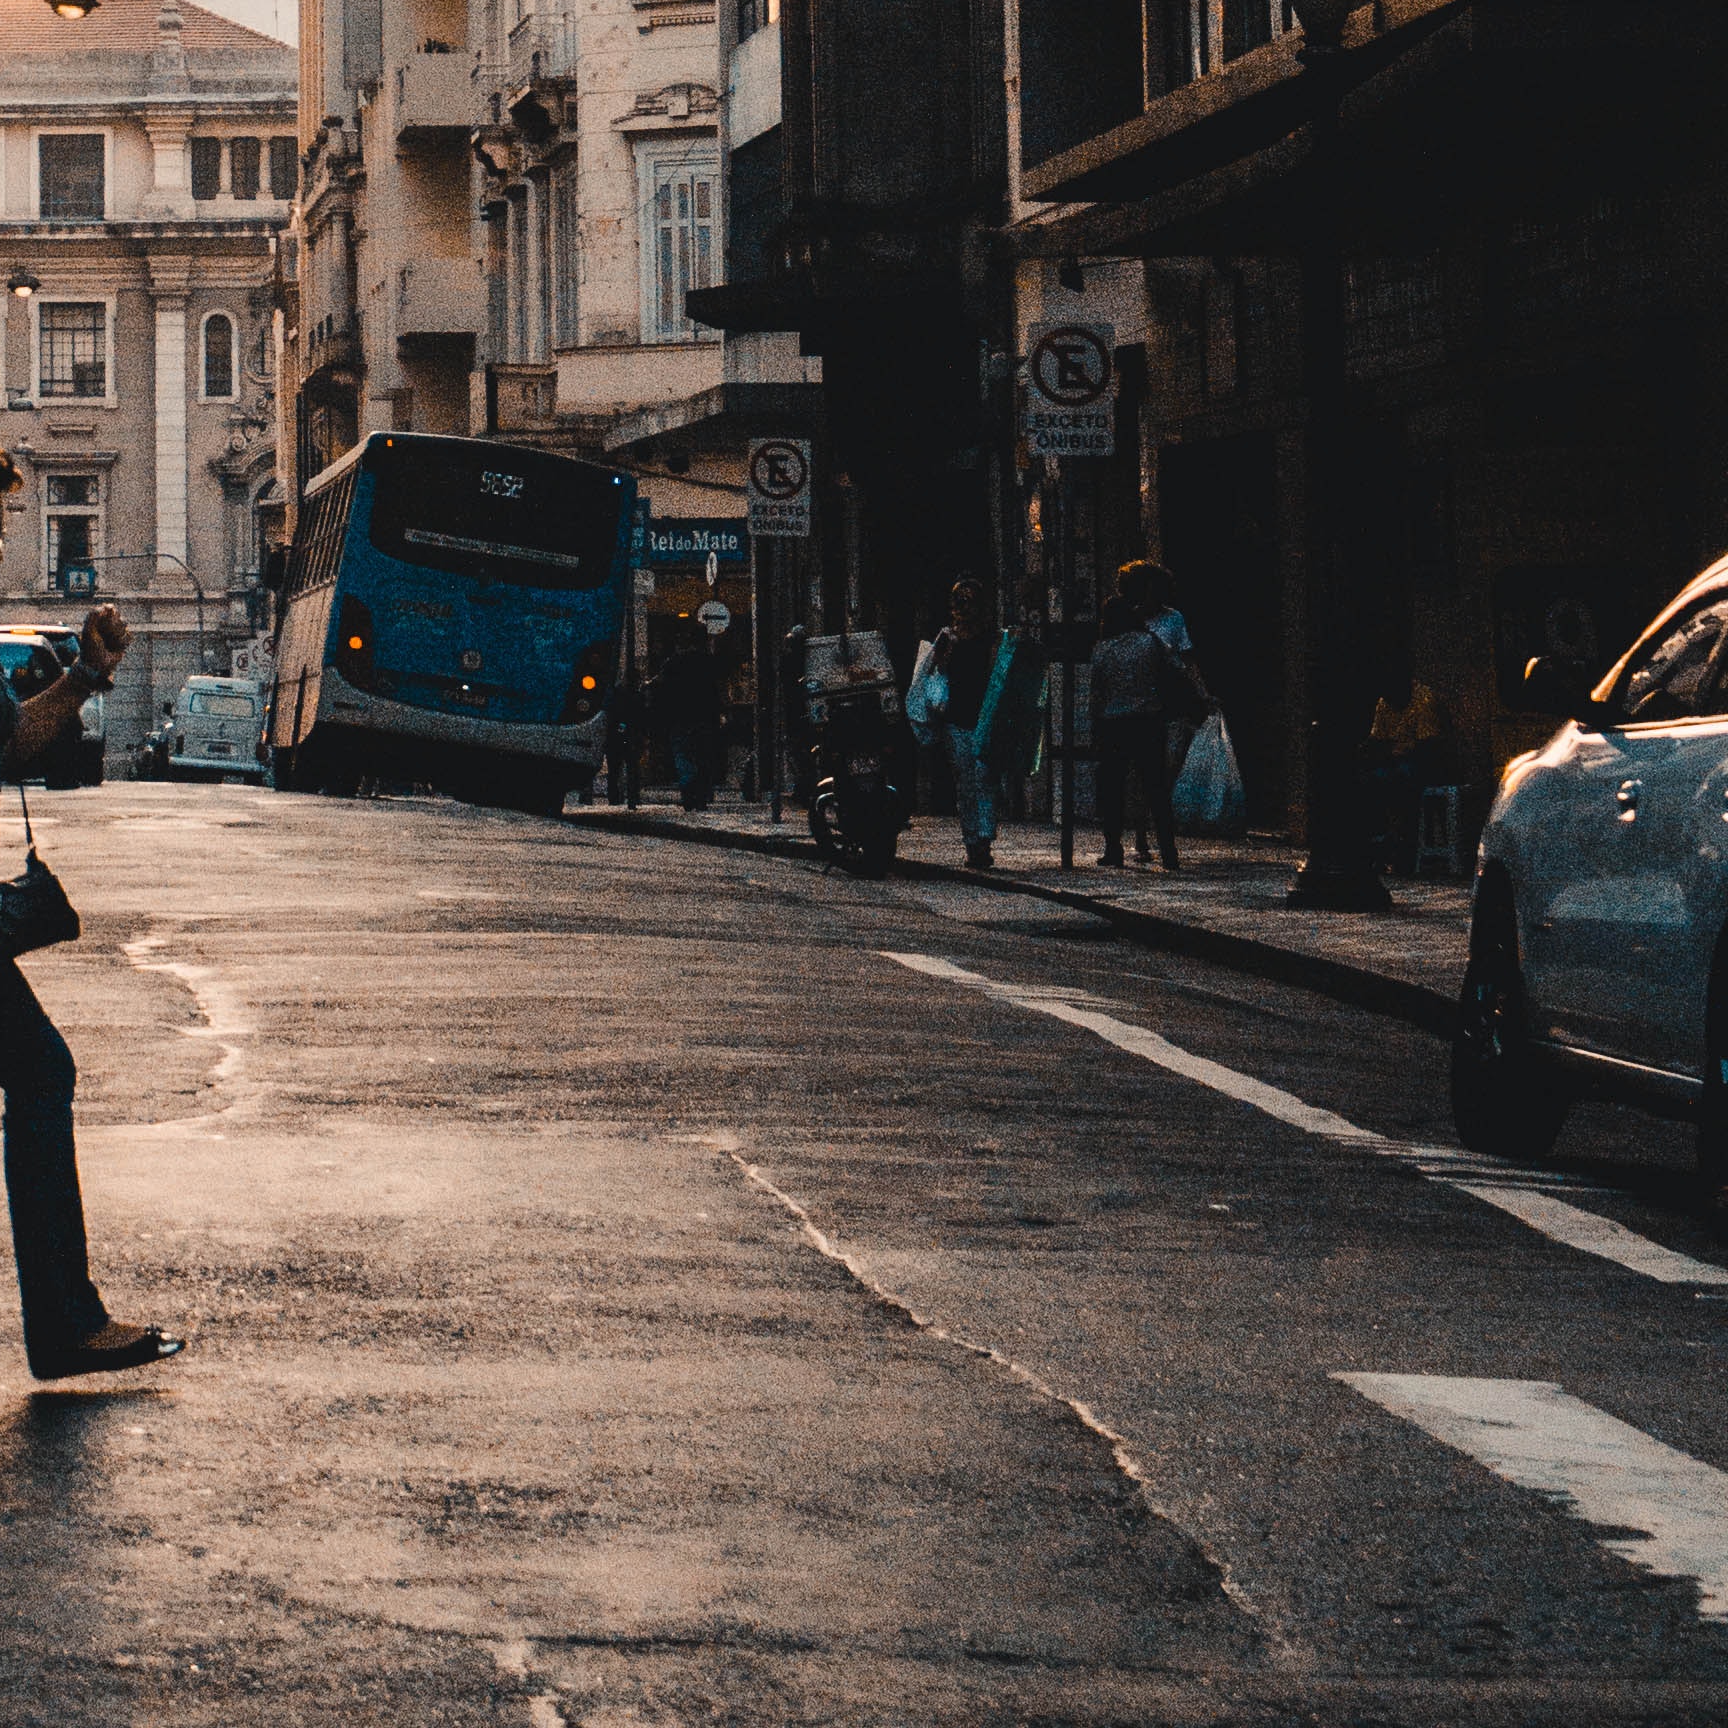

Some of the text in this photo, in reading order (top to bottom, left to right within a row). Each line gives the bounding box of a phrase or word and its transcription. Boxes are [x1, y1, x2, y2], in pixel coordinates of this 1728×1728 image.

[1036, 413, 1108, 429] EXCETO
[1036, 430, 1106, 449] ÔNIBUS
[753, 504, 805, 516] EXCETO
[692, 530, 738, 551] Mate
